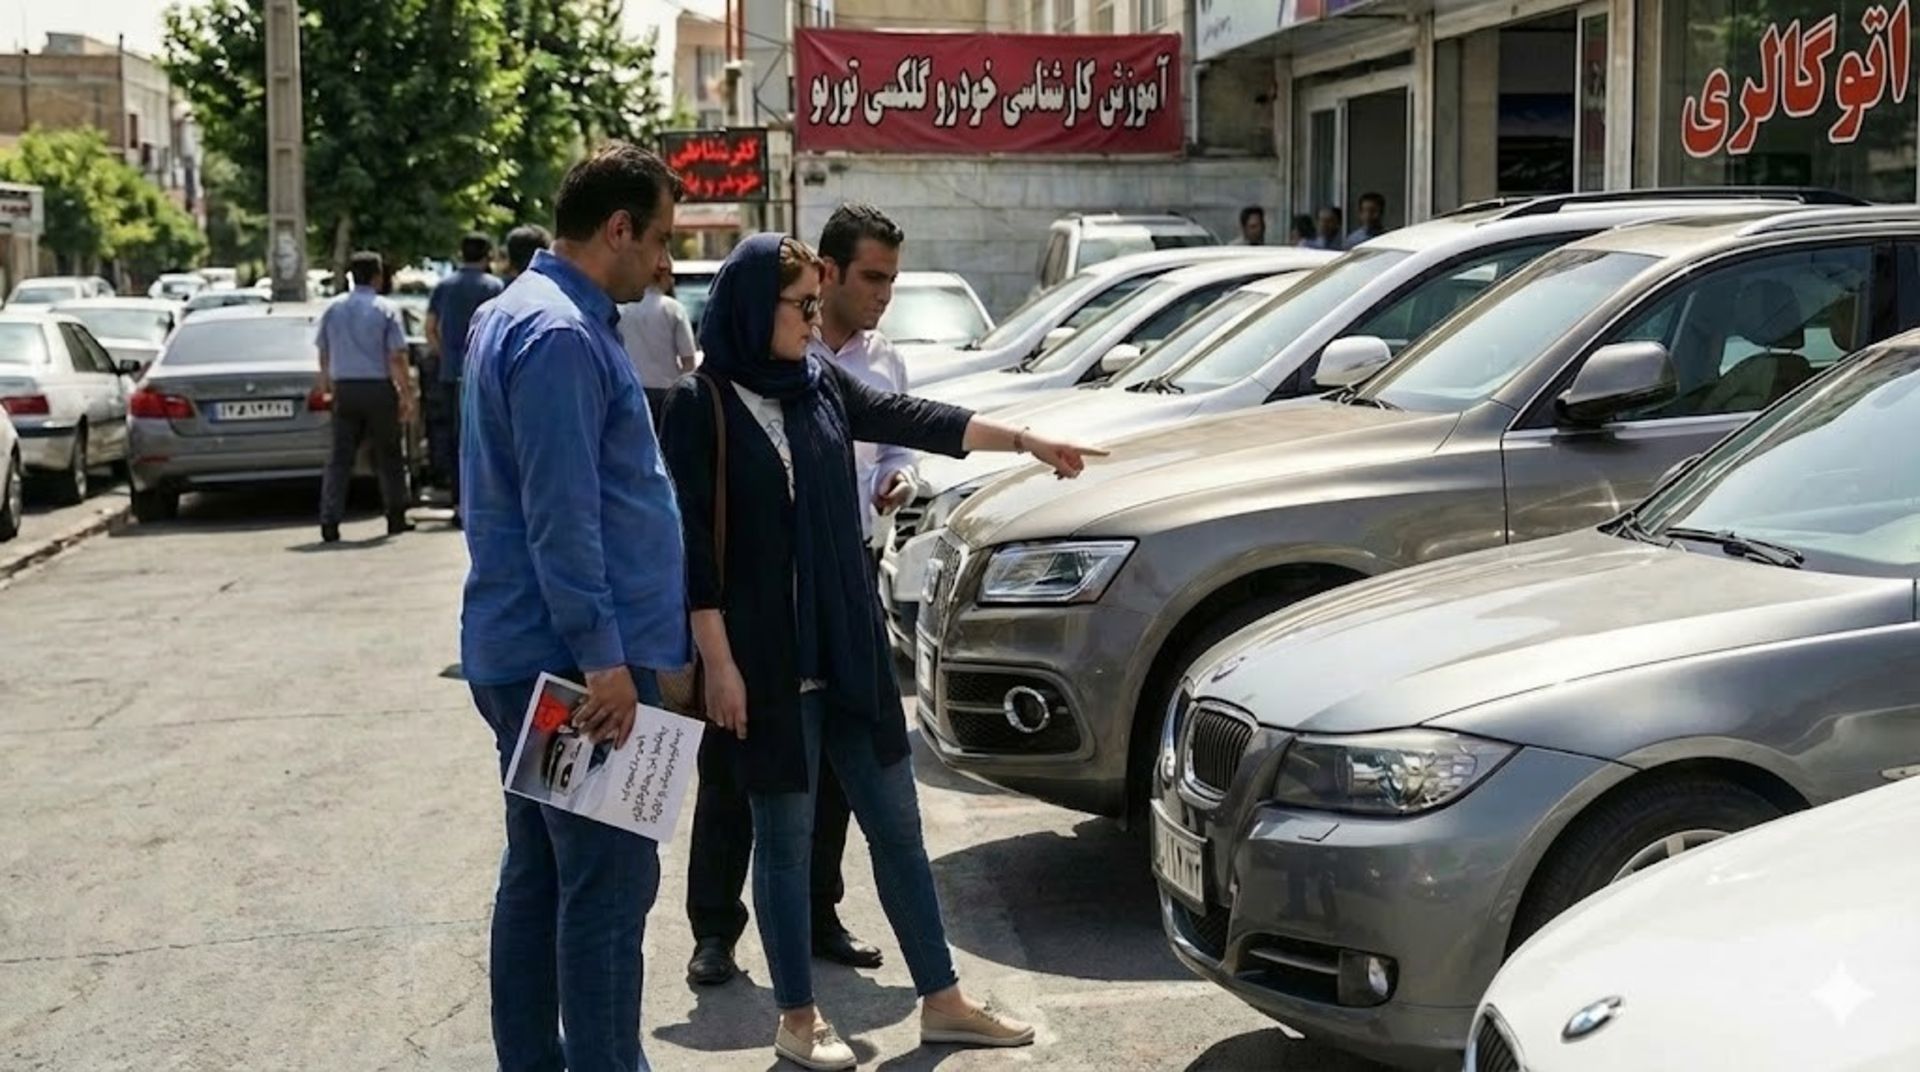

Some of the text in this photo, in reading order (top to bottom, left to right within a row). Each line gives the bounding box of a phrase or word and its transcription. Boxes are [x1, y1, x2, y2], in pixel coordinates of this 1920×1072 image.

[863, 56, 932, 125] گلکسی
[934, 58, 998, 127] خودرو
[1002, 58, 1096, 127] کارشناسی
[1099, 53, 1171, 127] آموزش
[1681, 0, 1910, 157] اتو گالری
